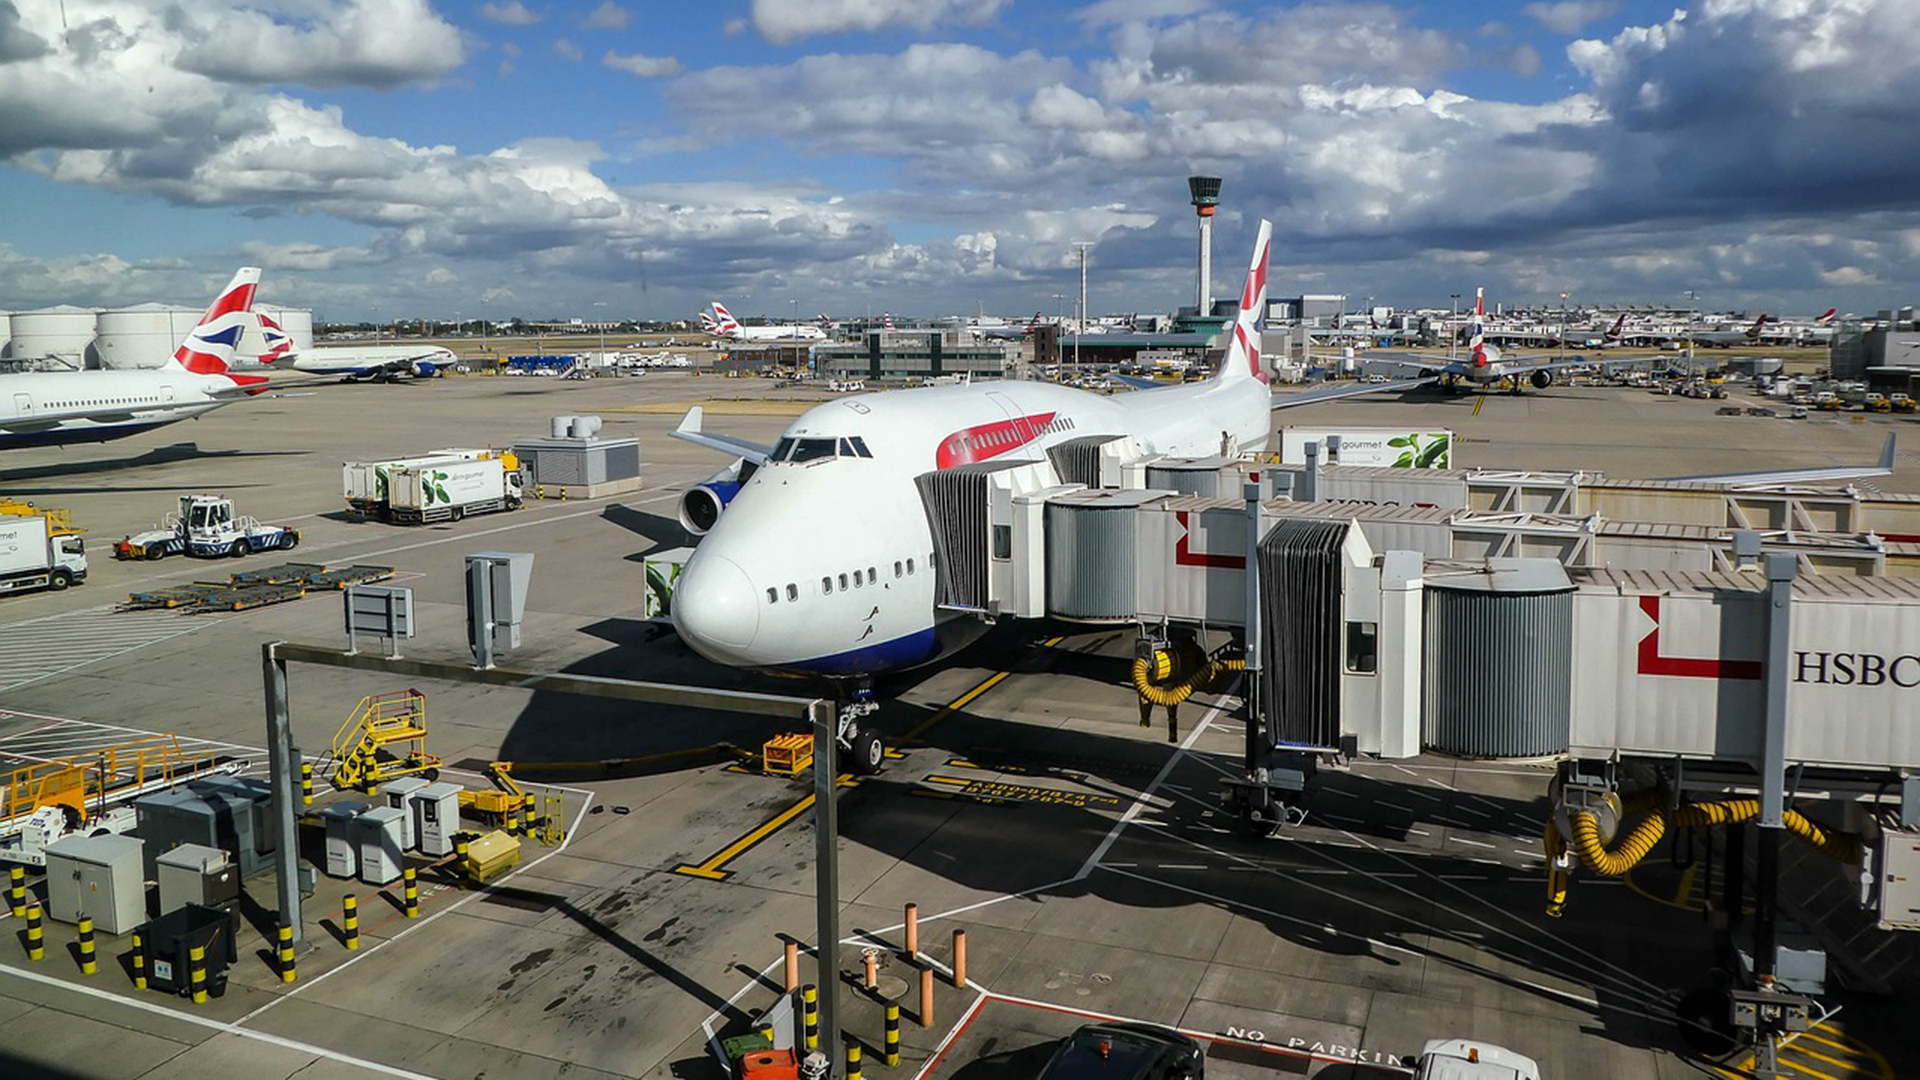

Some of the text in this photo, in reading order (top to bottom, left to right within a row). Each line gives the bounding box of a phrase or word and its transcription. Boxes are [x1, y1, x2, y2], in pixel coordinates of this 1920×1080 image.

[1793, 650, 1920, 688] HSBC
[1226, 1025, 1402, 1066] NO PARKIN
